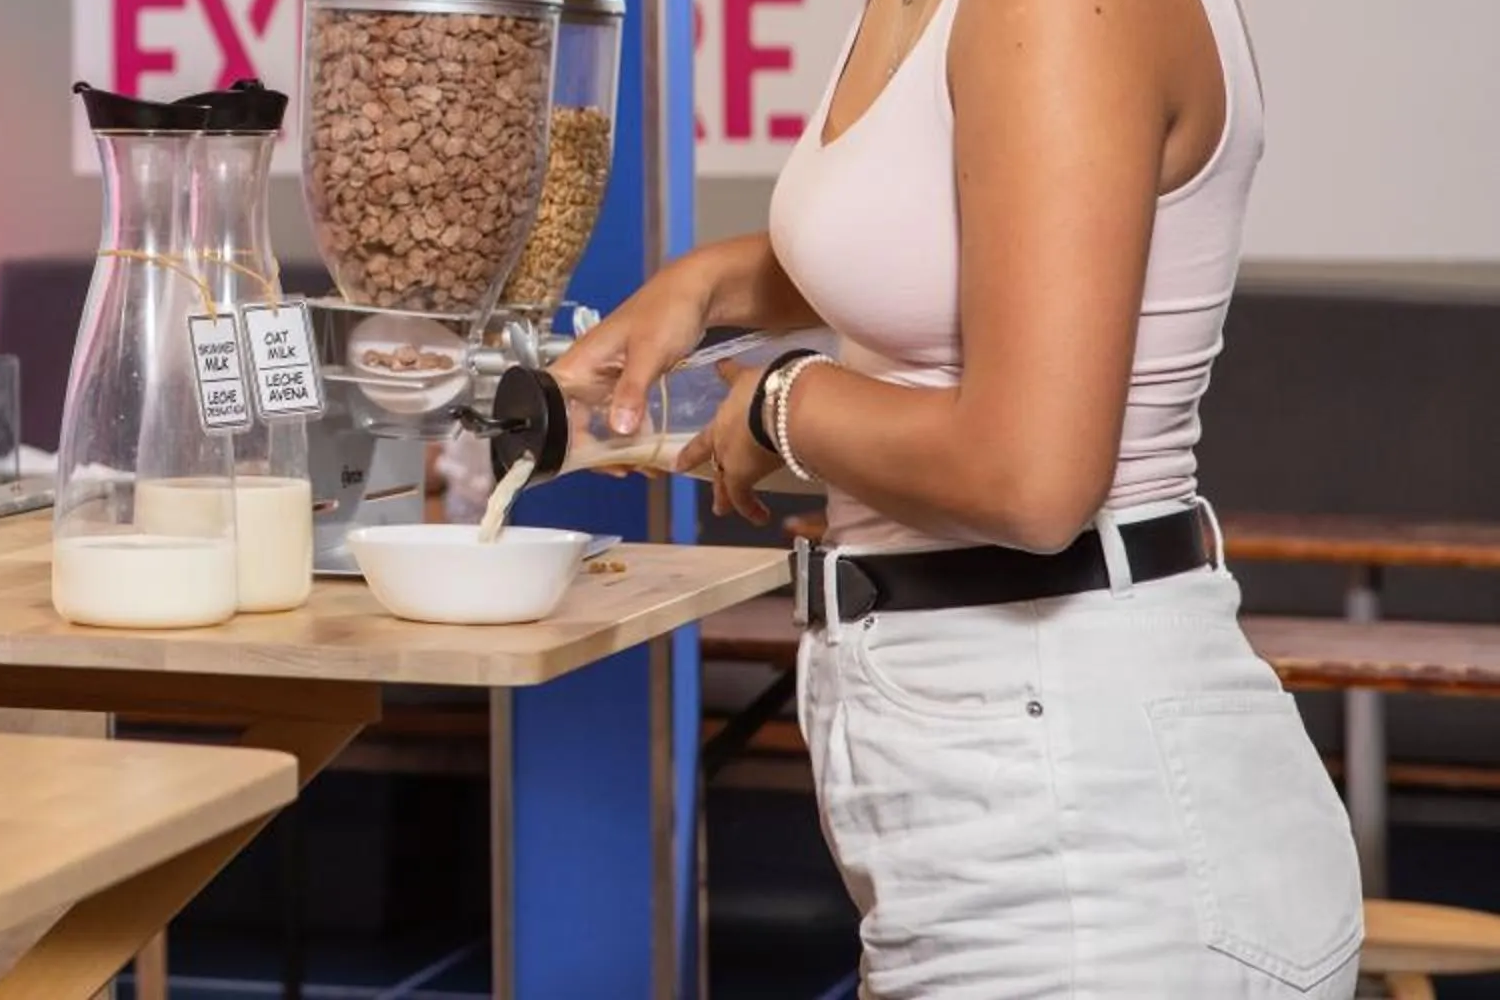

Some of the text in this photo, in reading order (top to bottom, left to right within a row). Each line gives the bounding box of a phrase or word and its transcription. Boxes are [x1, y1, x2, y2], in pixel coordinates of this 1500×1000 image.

[264, 330, 289, 345] OAT
[268, 345, 296, 360] MILK
[204, 355, 229, 372] MILK
[266, 371, 304, 387] LECHE
[207, 389, 237, 405] LECHE
[269, 386, 309, 403] AVENA
